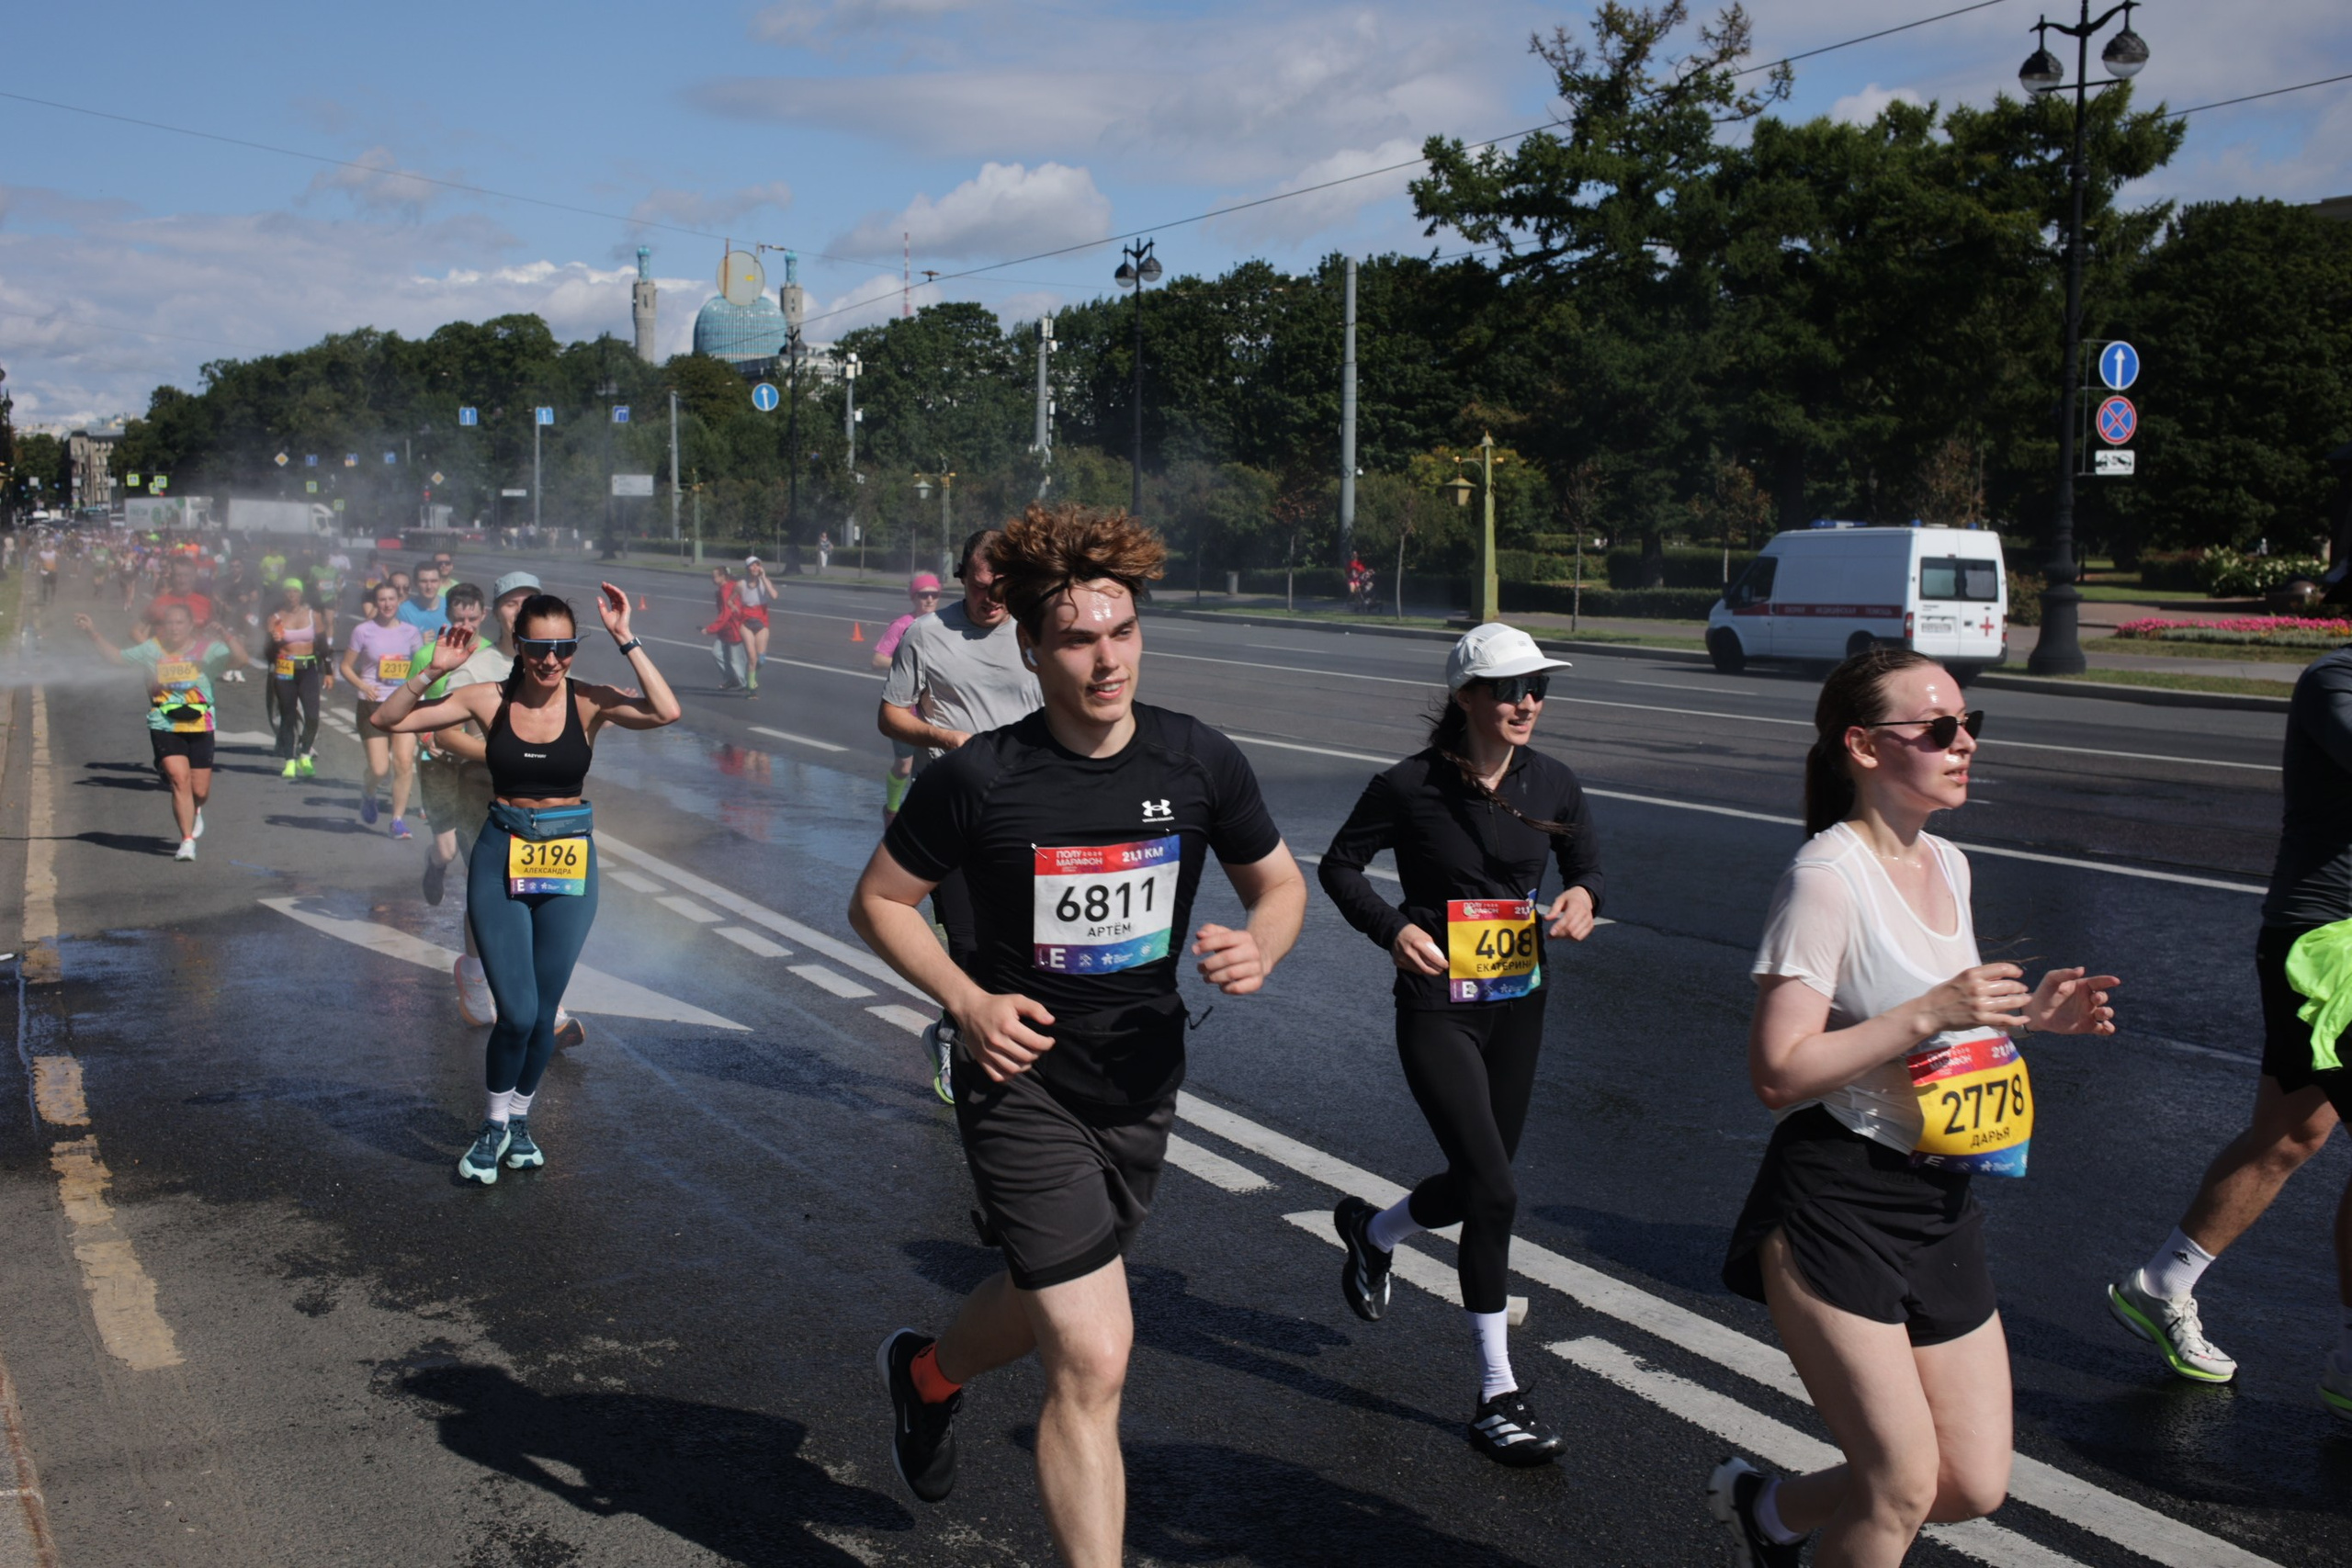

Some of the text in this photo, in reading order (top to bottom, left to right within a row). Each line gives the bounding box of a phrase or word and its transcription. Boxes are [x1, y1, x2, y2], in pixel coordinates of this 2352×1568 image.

[163, 663, 191, 677] 3986
[384, 663, 410, 673] 2317
[521, 844, 577, 866] 3196
[1056, 850, 1082, 859] ПОЛУ
[1056, 857, 1103, 866] МАРАФОН
[1122, 850, 1142, 863] 21,1
[1056, 877, 1155, 922] 6811
[1088, 922, 1132, 937] АРТЁМ
[1476, 928, 1532, 959] 408
[1049, 948, 1066, 968] E
[1476, 960, 1532, 973] ЕКАТЕРИН
[1941, 1074, 2025, 1134] 2778
[1970, 1126, 2010, 1148] ДАРЬЯ
